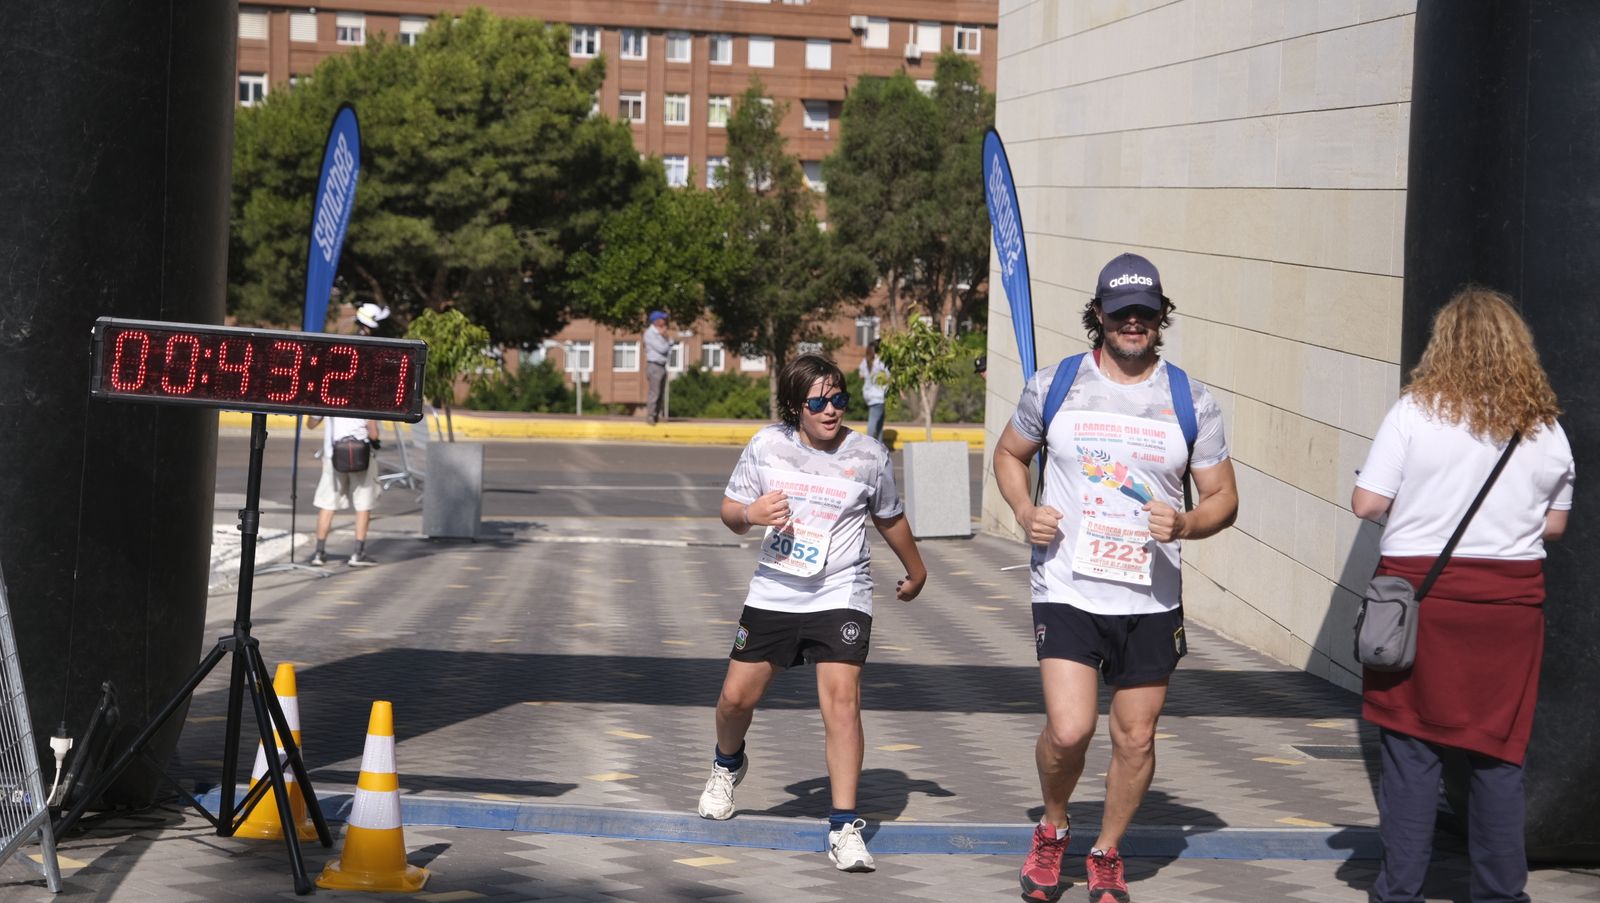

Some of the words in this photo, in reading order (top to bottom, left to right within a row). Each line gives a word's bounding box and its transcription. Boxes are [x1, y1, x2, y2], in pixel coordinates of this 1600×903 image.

[1109, 273, 1153, 288] adidas
[111, 331, 409, 406] 00:43:21
[1083, 423, 1122, 433] CARRERA
[1124, 425, 1140, 435] SIN
[1142, 427, 1167, 439] HUMO
[1141, 453, 1165, 464] JUNIO
[770, 533, 820, 564] 2052
[1089, 539, 1148, 565] 1223
